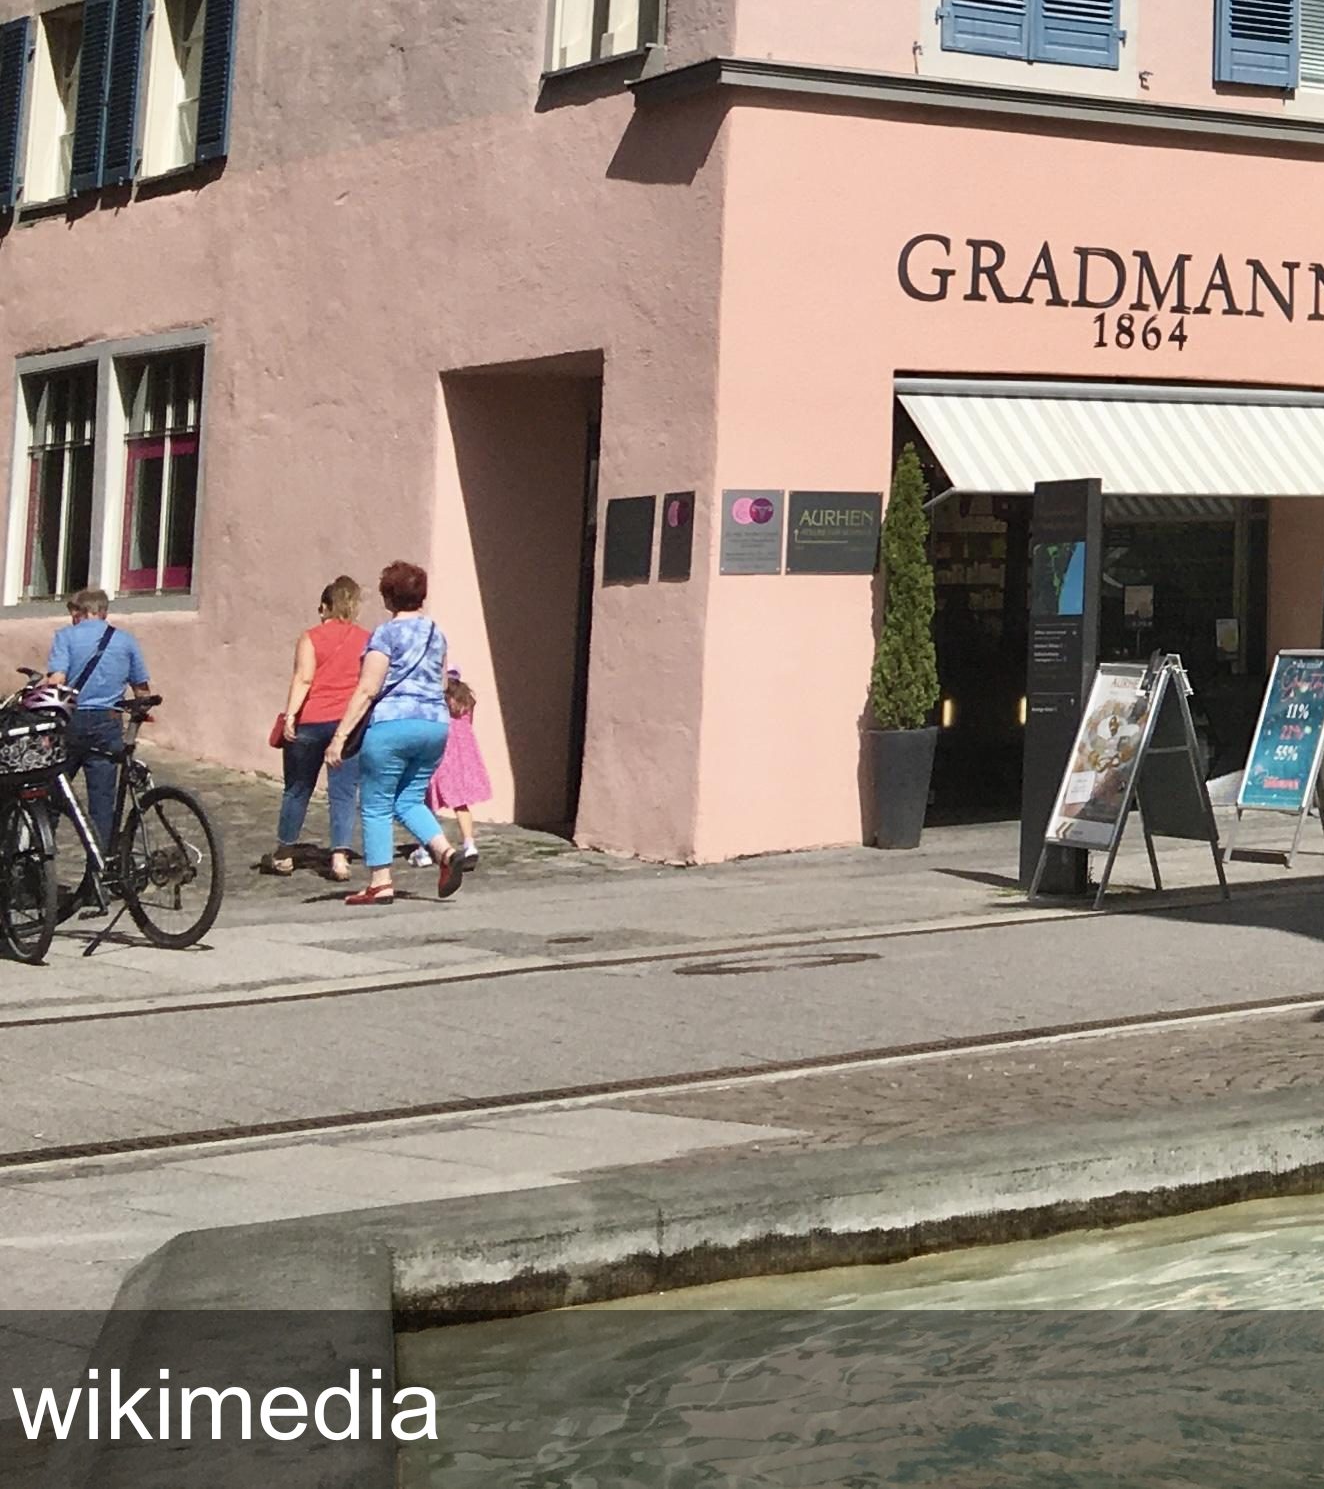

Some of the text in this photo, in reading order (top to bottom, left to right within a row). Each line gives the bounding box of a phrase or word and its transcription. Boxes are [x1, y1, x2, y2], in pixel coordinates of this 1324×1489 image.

[1092, 312, 1189, 352] 1864
[799, 509, 874, 527] AURHEN
[1286, 703, 1310, 720] 11%
